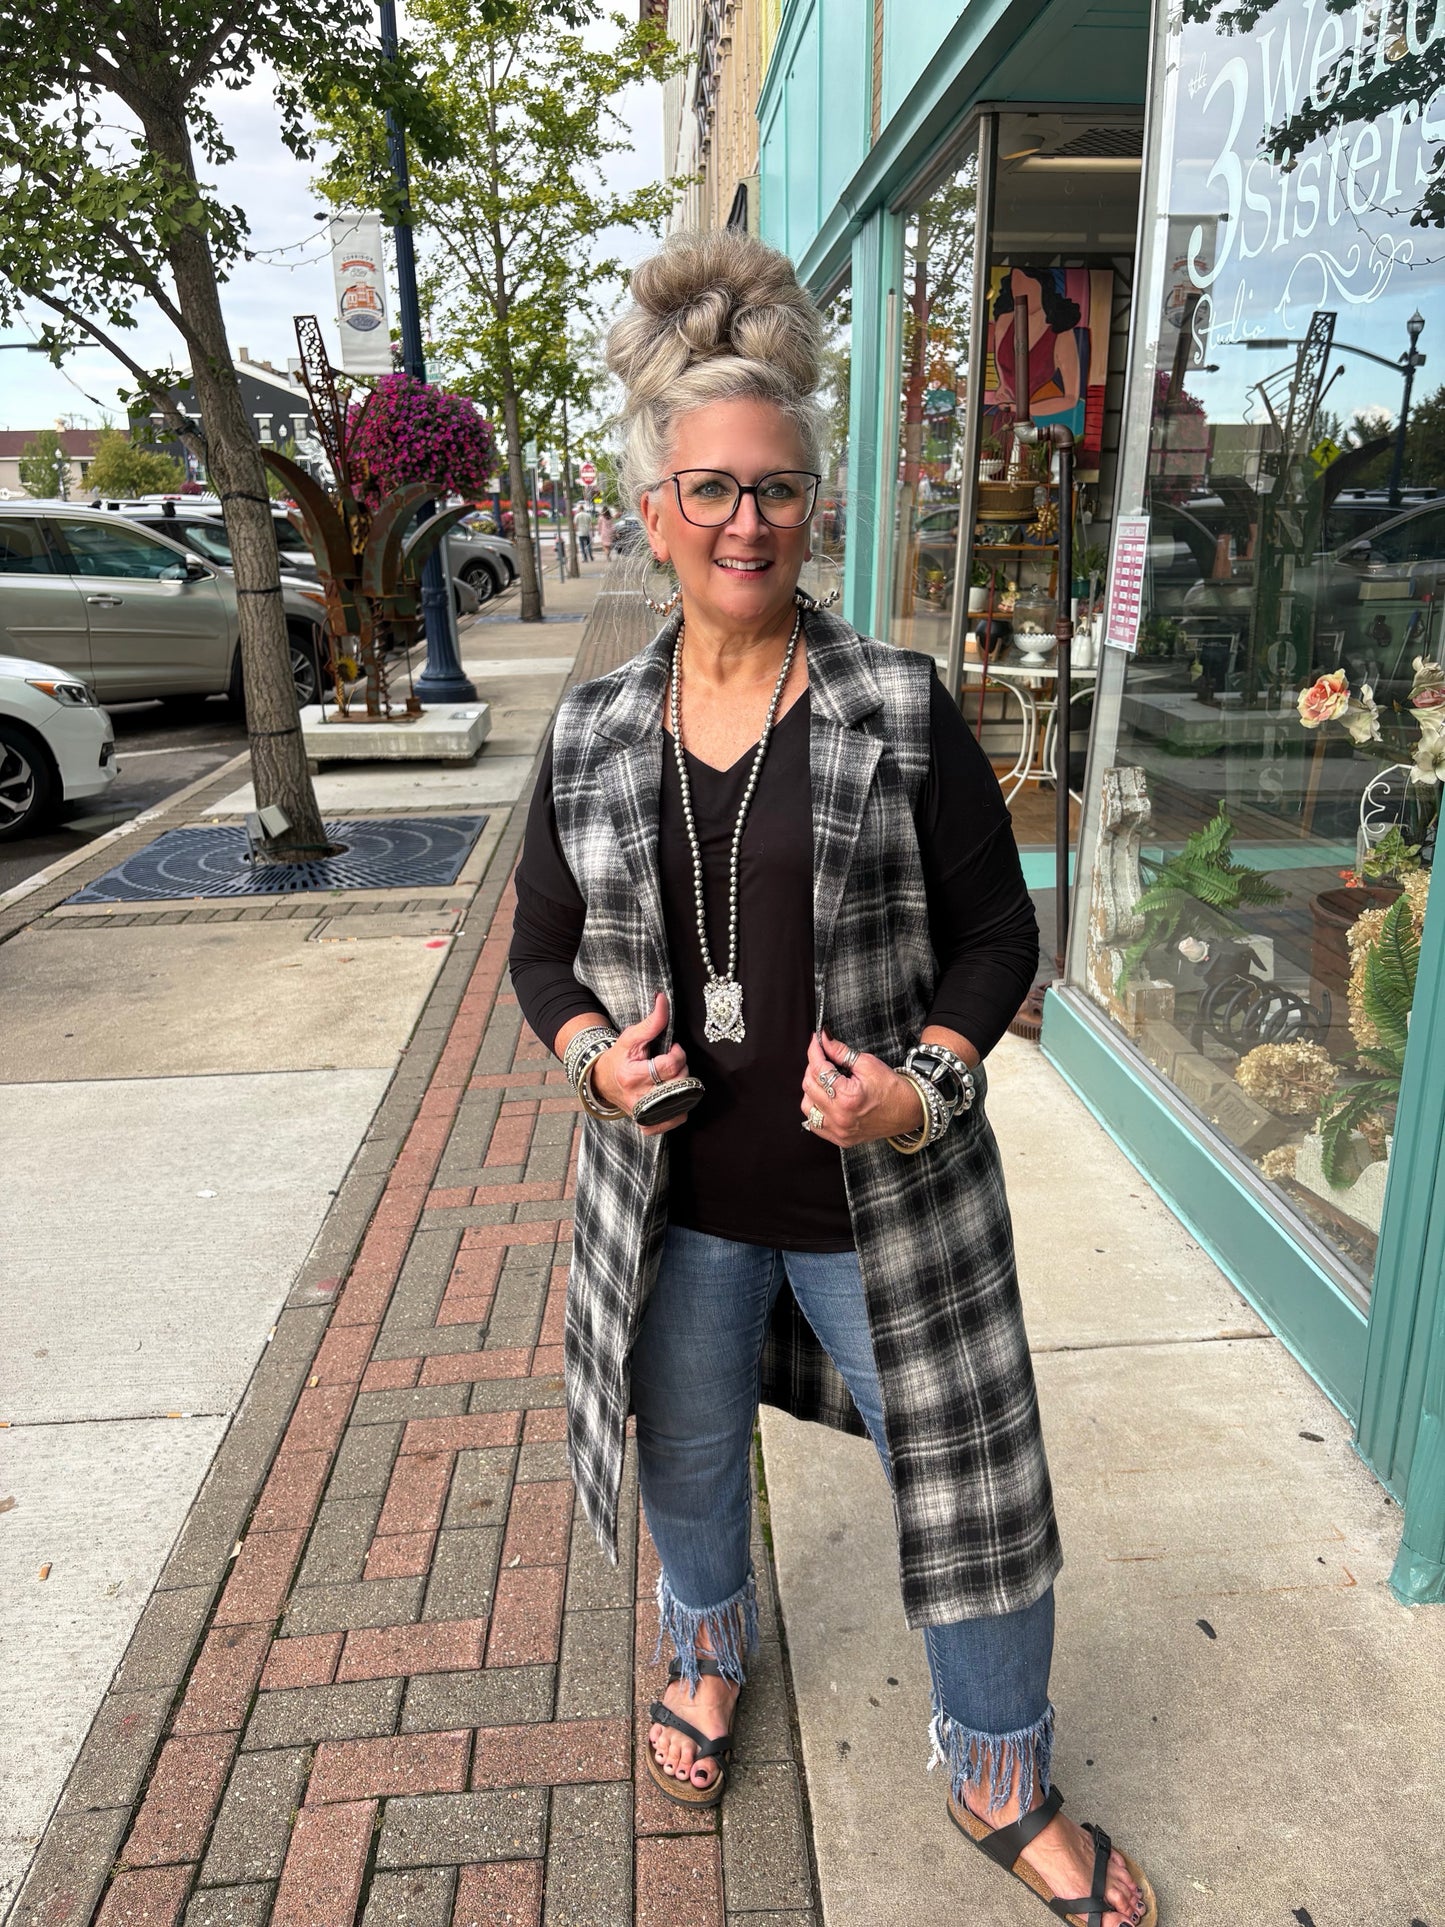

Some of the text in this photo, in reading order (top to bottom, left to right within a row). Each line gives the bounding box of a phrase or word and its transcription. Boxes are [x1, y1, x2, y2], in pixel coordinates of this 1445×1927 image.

[1188, 56, 1249, 289] 3
[1191, 278, 1266, 365] Studio
[1256, 465, 1309, 804] ANTIQUES
